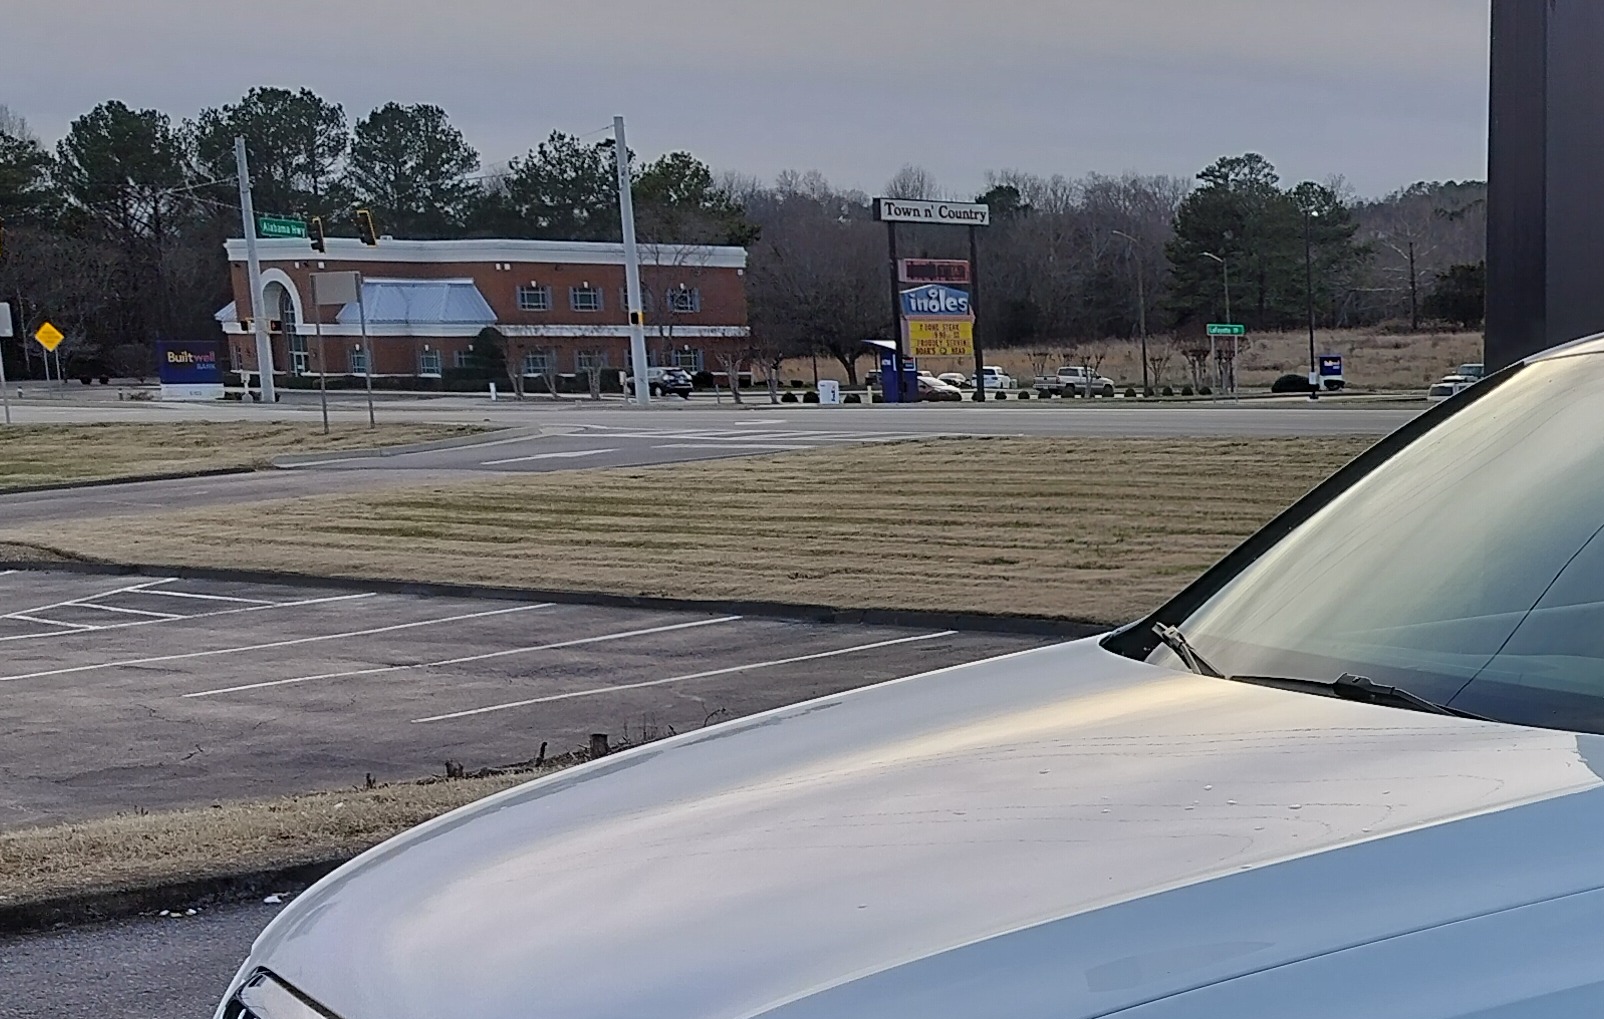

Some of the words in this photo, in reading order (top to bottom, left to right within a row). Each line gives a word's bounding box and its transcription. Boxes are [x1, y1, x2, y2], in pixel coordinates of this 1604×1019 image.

[884, 202, 921, 217] Town
[938, 205, 987, 222] Country
[263, 222, 291, 234] Alabama
[291, 225, 306, 238] Hwy
